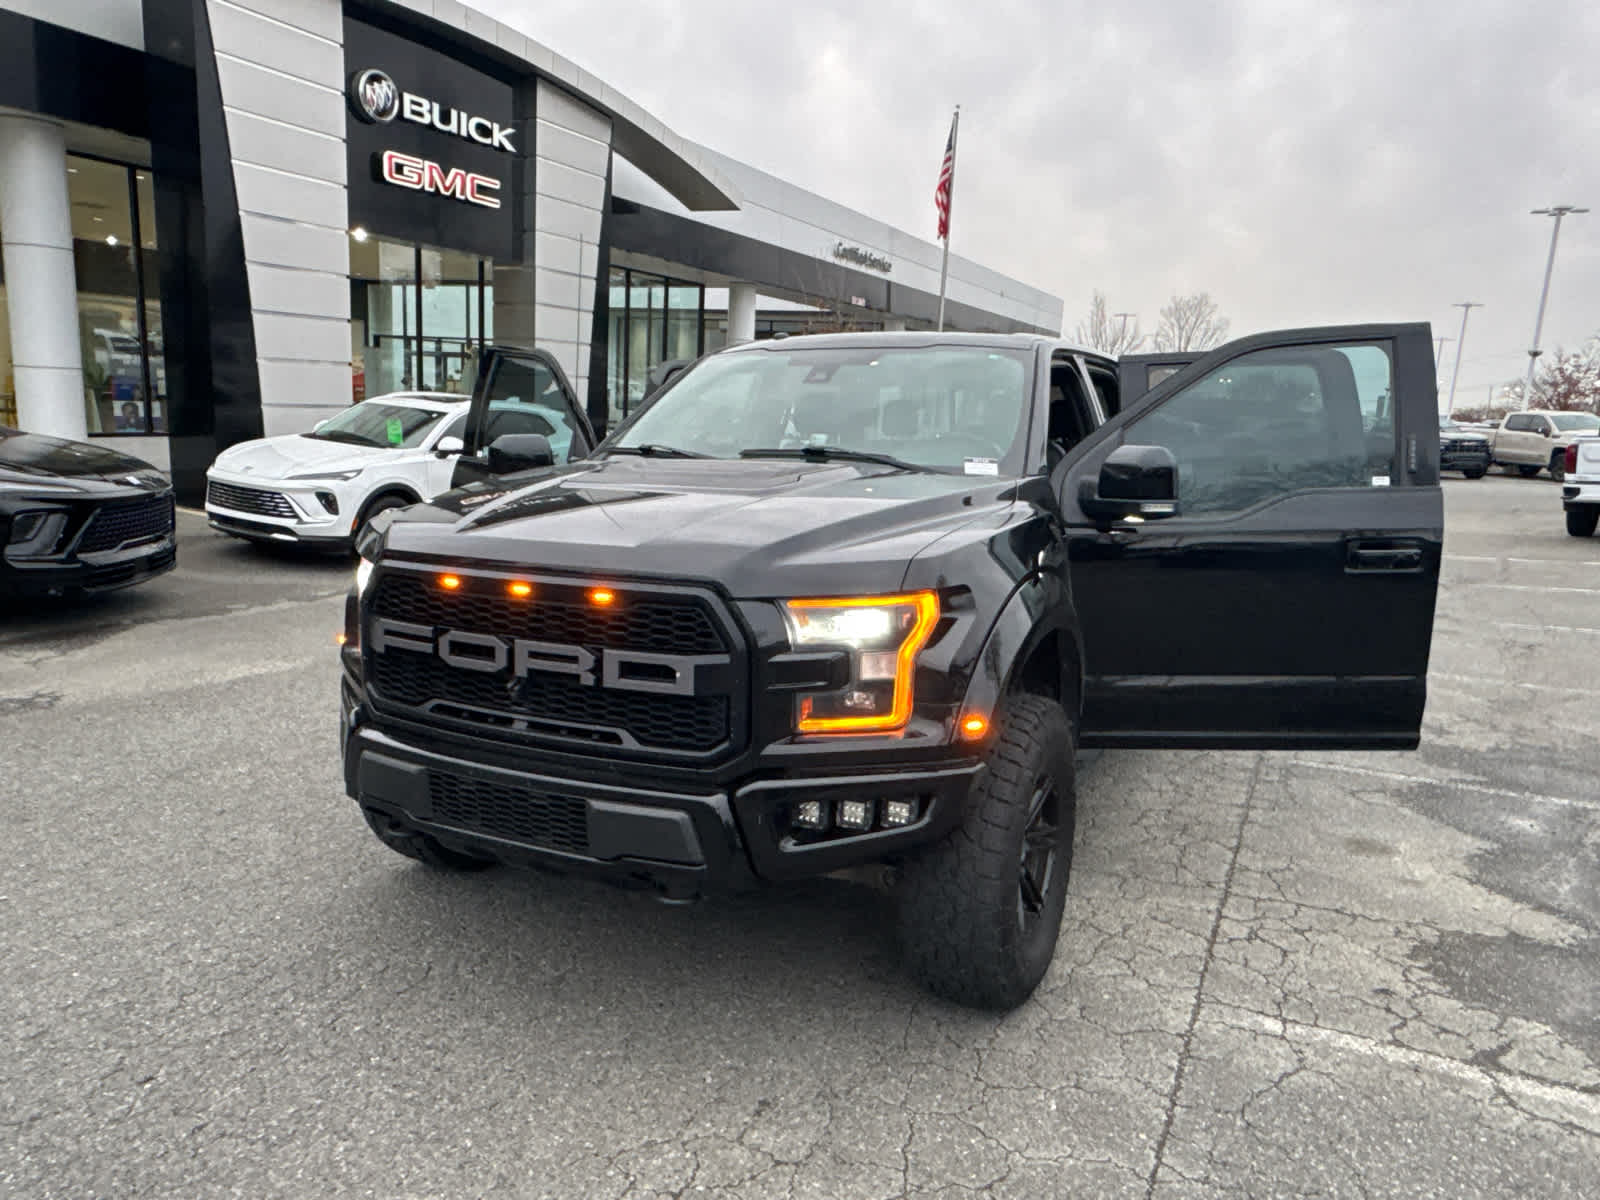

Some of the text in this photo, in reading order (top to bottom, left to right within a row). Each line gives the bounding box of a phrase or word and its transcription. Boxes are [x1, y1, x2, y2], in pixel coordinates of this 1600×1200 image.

[402, 91, 516, 153] BUICK
[382, 150, 501, 209] GMC
[371, 616, 696, 697] FORD
